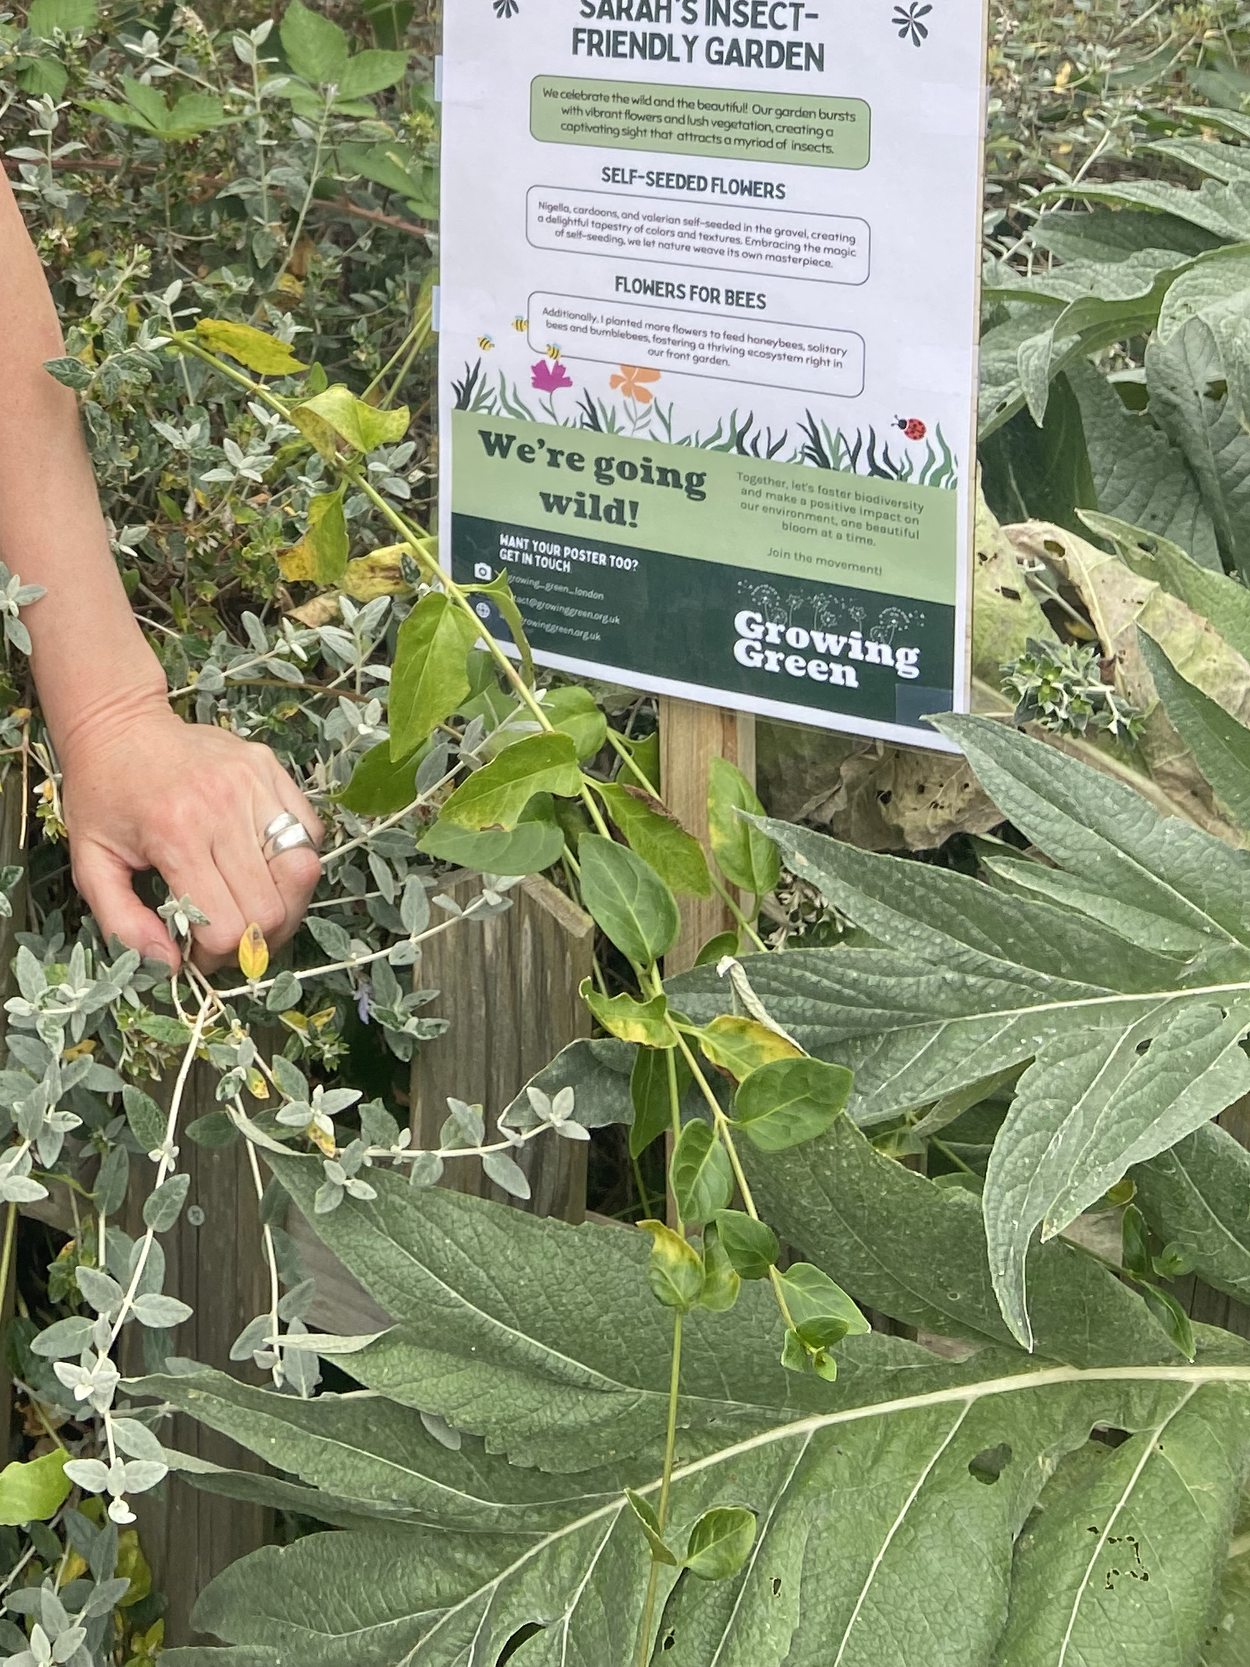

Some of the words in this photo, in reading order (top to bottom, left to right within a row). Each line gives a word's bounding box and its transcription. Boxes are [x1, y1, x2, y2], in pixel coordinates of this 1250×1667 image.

[572, 27, 699, 63] FRIENDLY
[705, 36, 825, 72] GARDEN
[543, 88, 558, 98] We
[560, 89, 609, 102] celebrate
[612, 93, 629, 104] the
[632, 95, 651, 106] wild
[654, 97, 674, 108] and
[677, 98, 695, 109] the
[697, 100, 748, 113] beautiful!
[752, 104, 773, 115] Our
[775, 107, 816, 119] garden
[819, 109, 856, 122] bursts
[561, 106, 583, 116] with
[585, 107, 622, 119] vibrant
[624, 110, 662, 123] flowers
[664, 113, 685, 125] and
[687, 116, 709, 126] lush
[711, 119, 774, 133] vegetation,
[776, 124, 824, 139] creating
[826, 128, 834, 137] a
[561, 122, 620, 138] captivating
[622, 127, 648, 139] sight
[651, 129, 673, 140] that
[677, 131, 722, 144] attracts
[724, 137, 731, 145] a
[734, 137, 773, 149] myriad
[776, 139, 788, 149] of
[791, 140, 834, 154] insects.
[602, 167, 707, 192] SELF-SEEDED
[711, 177, 786, 199] FLOWERS
[539, 201, 571, 214] Nigella,
[573, 207, 619, 219] cardoons,
[621, 211, 640, 220] and
[642, 213, 680, 224] valerian
[683, 218, 741, 231] self-seeded
[743, 222, 752, 232] in
[755, 224, 772, 235] the
[774, 228, 809, 239] gravel,
[811, 232, 856, 245] creating
[546, 215, 589, 228] delightful
[591, 220, 632, 234] tapestry
[634, 225, 644, 233] of
[645, 226, 675, 237] colors
[677, 230, 696, 239] and
[699, 232, 743, 244] textures.
[745, 238, 800, 253] Embracing
[803, 243, 821, 253] the
[823, 246, 856, 258] magic
[555, 229, 565, 237] of
[628, 238, 641, 246] we
[643, 238, 655, 247] let
[658, 242, 690, 252] nature
[693, 247, 725, 255] weave
[727, 248, 739, 257] its
[742, 251, 762, 260] own
[765, 253, 833, 268] masterpiece.
[615, 276, 686, 301] FLOWERS
[689, 286, 720, 305] FOR
[725, 289, 766, 310] BEES
[546, 320, 567, 331] bees
[570, 324, 588, 333] and
[590, 326, 651, 343] bumblebees,
[652, 334, 696, 350] fostering
[707, 341, 745, 357] thriving
[748, 350, 803, 363] ecosystem
[806, 356, 831, 368] right
[833, 360, 842, 369] in
[606, 317, 642, 328] planted
[645, 323, 670, 332] more
[673, 325, 707, 337] flowers
[710, 330, 720, 339] to
[723, 331, 745, 342] feed
[747, 334, 805, 351] honeybees,
[807, 344, 847, 357] solitary
[666, 348, 690, 361] front
[693, 355, 730, 366] garden.
[594, 455, 706, 502] going
[737, 472, 788, 490] Together,
[818, 485, 851, 499] foster
[855, 491, 924, 515] biodiversity
[540, 490, 639, 529] wild!
[741, 487, 762, 498] and
[765, 491, 797, 504] make
[800, 497, 806, 506] a
[810, 499, 856, 514] positive
[860, 506, 901, 522] impact
[904, 516, 919, 525] on
[741, 502, 760, 512] our
[762, 506, 838, 526] environment,
[841, 520, 863, 530] one
[866, 521, 920, 540] beautiful
[782, 521, 818, 535] bloom
[821, 529, 832, 539] at
[836, 532, 842, 540] a
[846, 534, 876, 546] time.
[500, 534, 529, 548] WANT
[532, 539, 560, 556] YOUR
[563, 546, 607, 565] POSTER
[609, 555, 639, 572] TOO?
[500, 548, 520, 562] GET
[522, 552, 532, 565] IN
[535, 555, 571, 573] TOUCH
[767, 547, 790, 560] Join
[794, 551, 812, 564] the
[816, 555, 882, 576] movement!
[733, 638, 859, 688] Green
[734, 610, 921, 679] Growing
